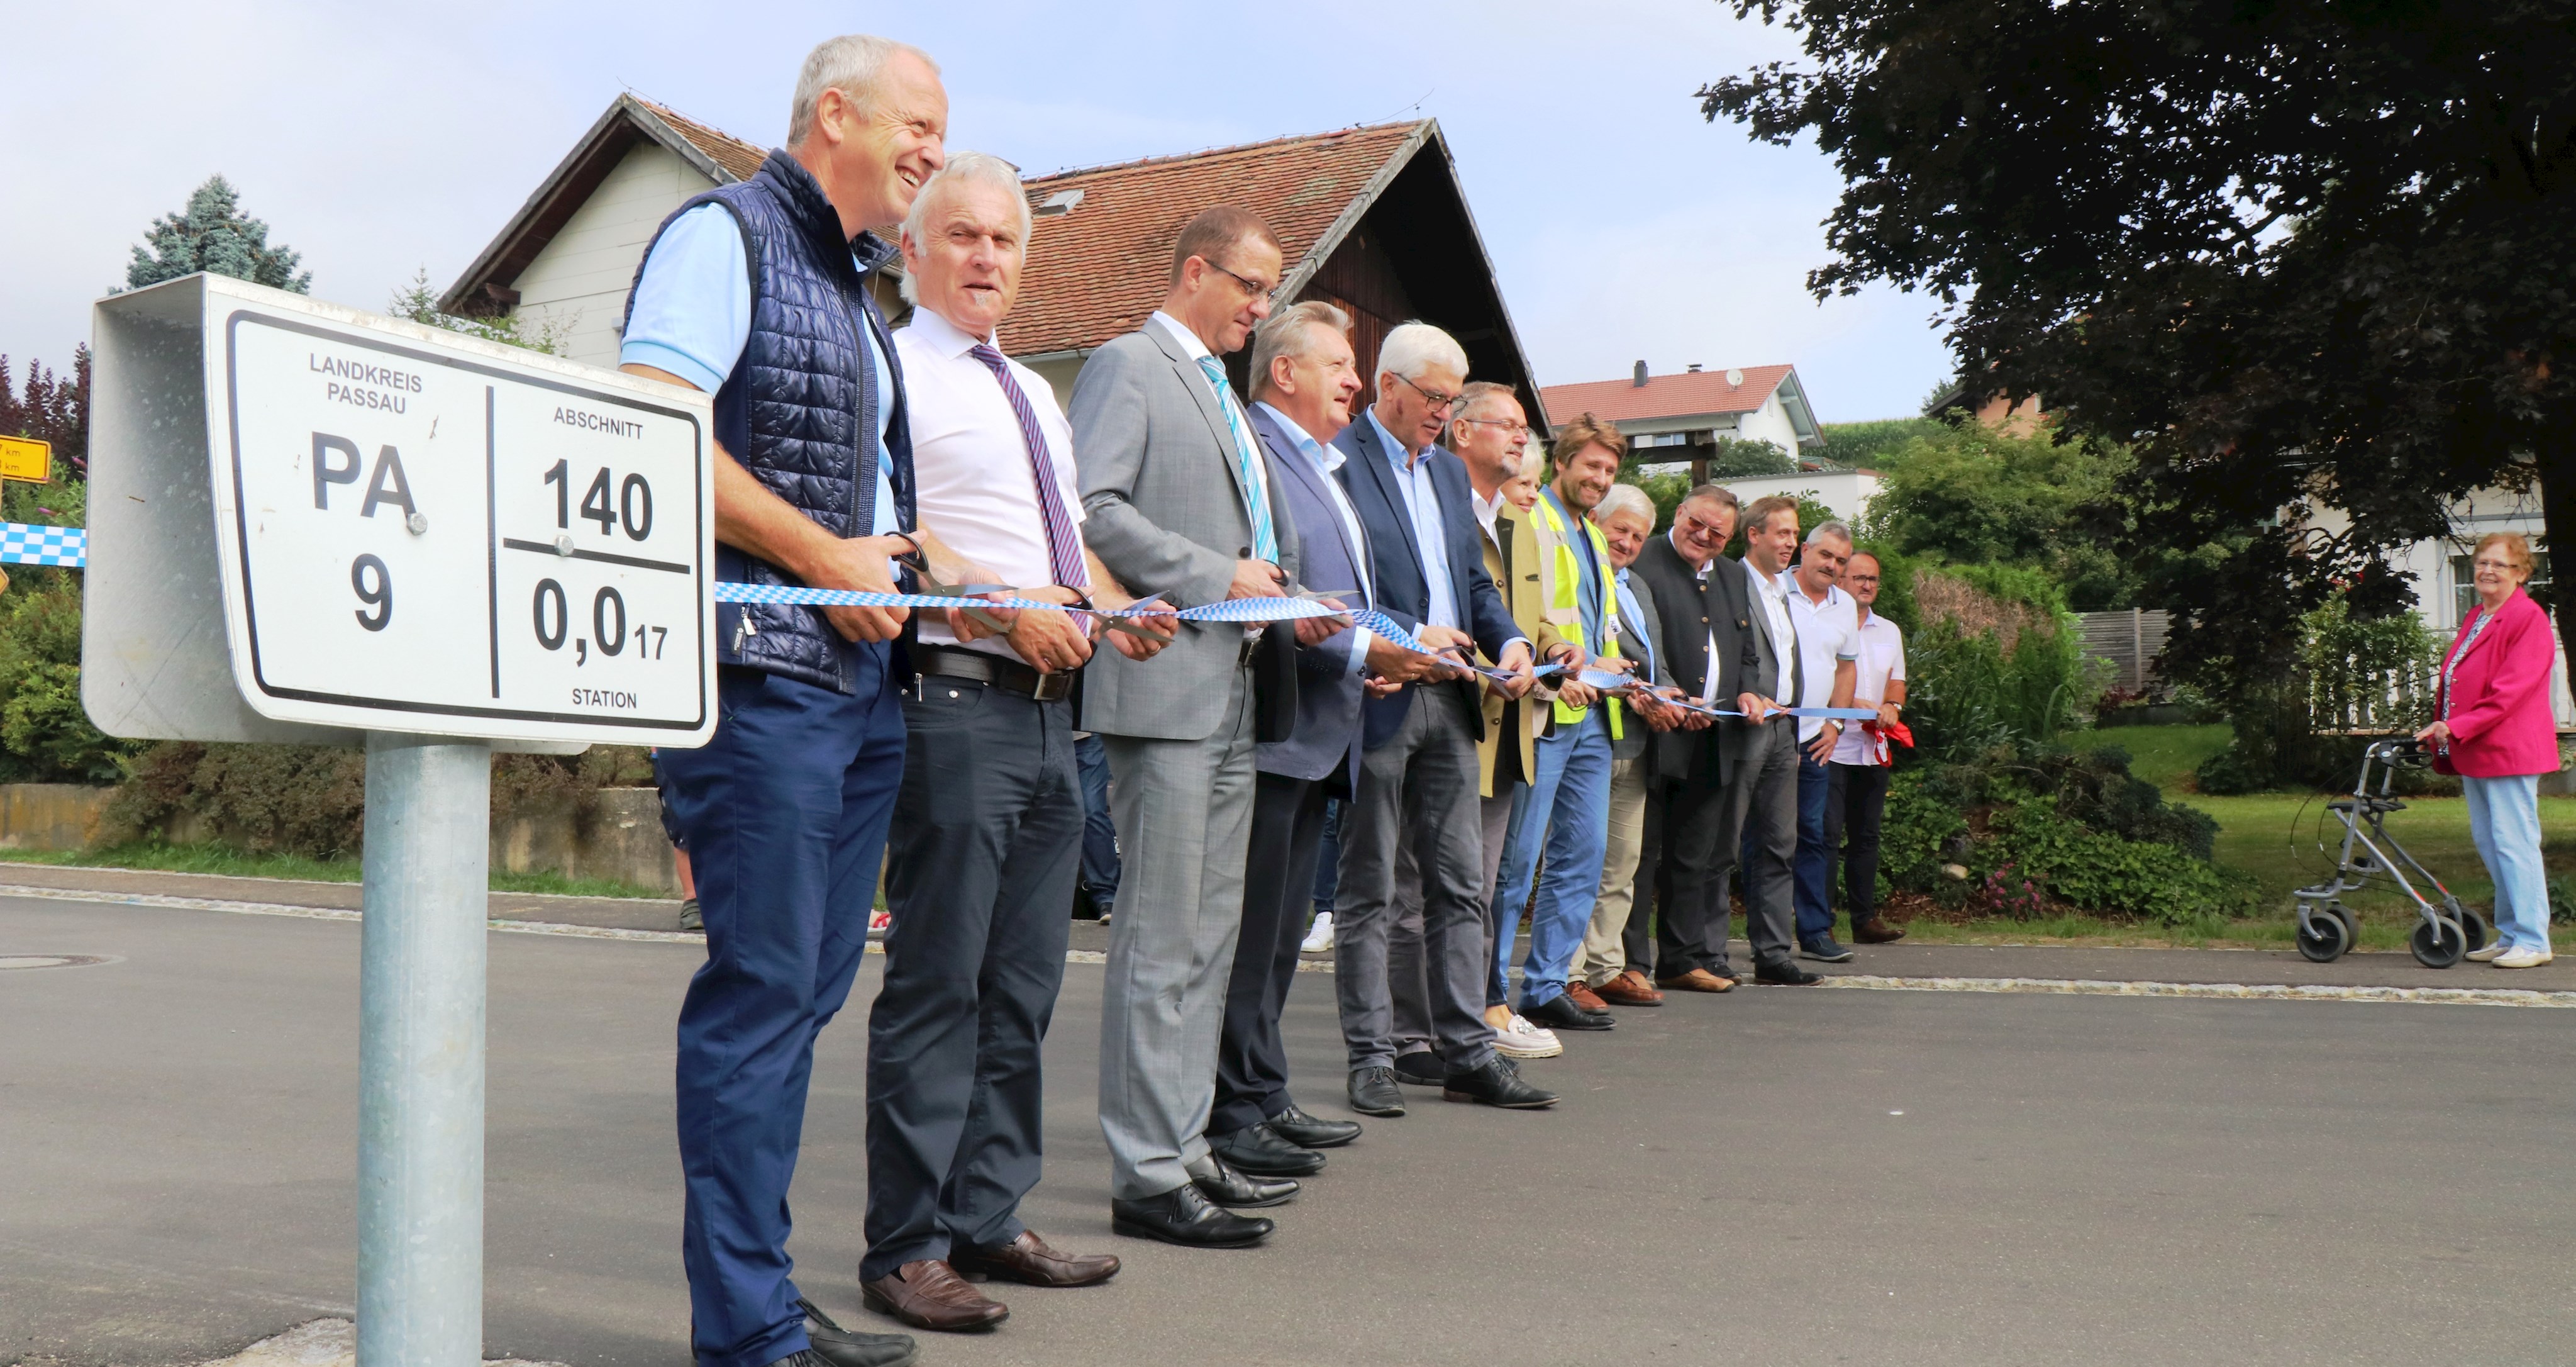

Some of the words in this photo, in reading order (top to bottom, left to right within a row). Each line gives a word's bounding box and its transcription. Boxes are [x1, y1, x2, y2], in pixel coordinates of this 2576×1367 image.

[310, 352, 422, 393] LANDKREIS
[328, 382, 406, 415] PASSAU
[553, 406, 643, 440] ABSCHNITT
[5, 462, 20, 472] km
[6, 448, 21, 457] km
[312, 431, 417, 523] PA
[543, 459, 653, 542] 140
[352, 553, 392, 632] 9
[572, 689, 637, 710] STATION
